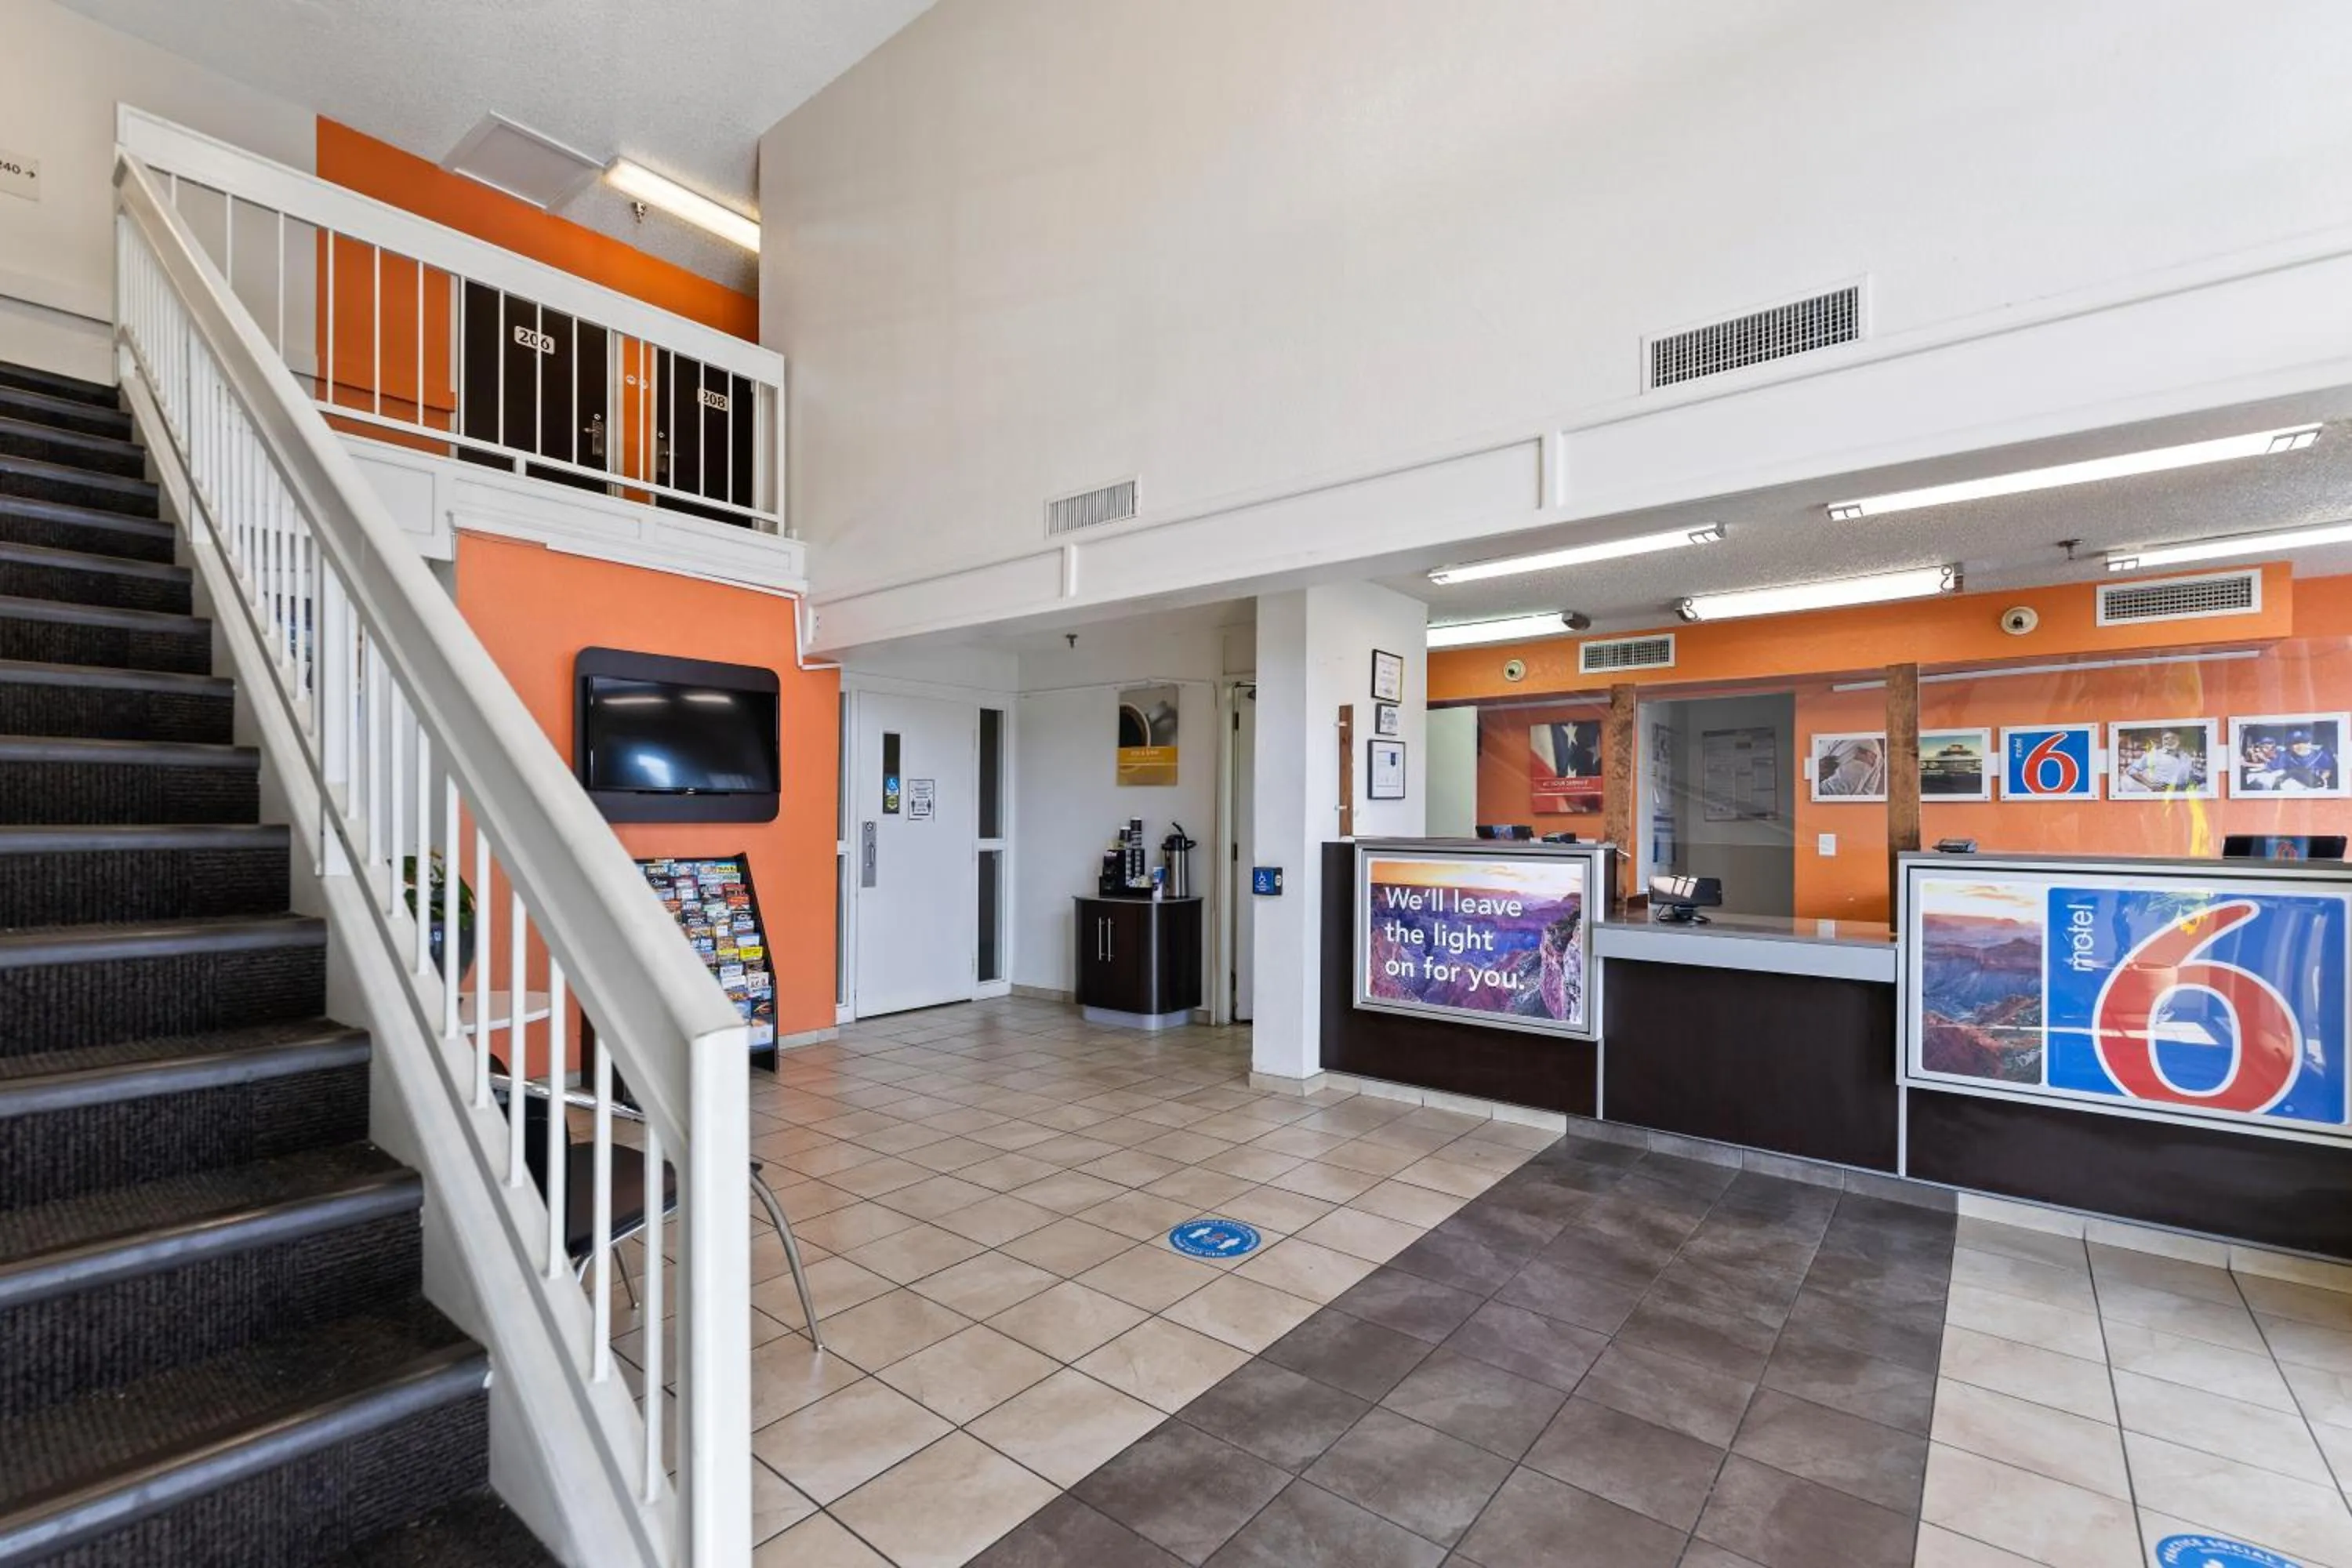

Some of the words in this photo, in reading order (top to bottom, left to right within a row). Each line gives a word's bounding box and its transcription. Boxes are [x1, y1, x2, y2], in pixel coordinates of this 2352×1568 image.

[0, 160, 21, 174] 40
[518, 329, 550, 350] 206
[704, 392, 725, 408] 208
[2023, 731, 2079, 793] 6
[1385, 887, 1443, 912] We'll
[1454, 889, 1523, 916] leave
[1385, 920, 1425, 945] the
[1434, 923, 1494, 954] light
[2067, 903, 2094, 972] motel
[1385, 960, 1414, 978] on
[1424, 956, 1461, 983] for
[1468, 969, 1526, 992] you.
[2091, 899, 2303, 1115] 6
